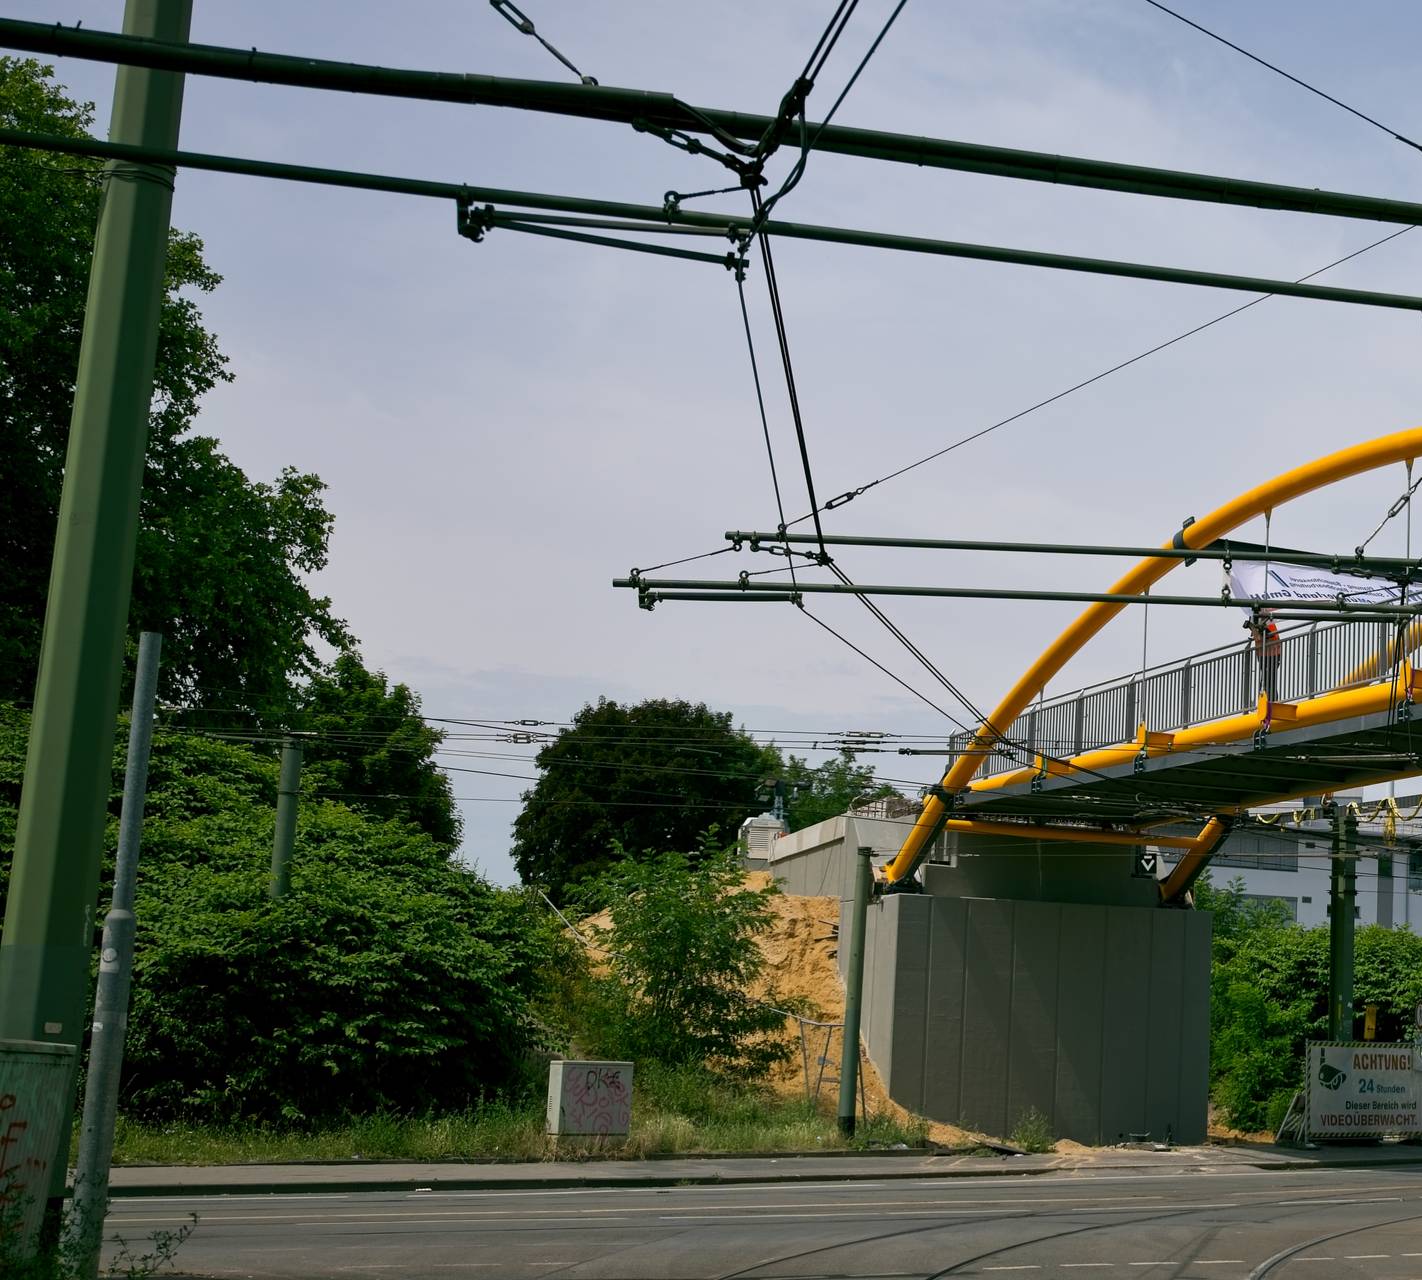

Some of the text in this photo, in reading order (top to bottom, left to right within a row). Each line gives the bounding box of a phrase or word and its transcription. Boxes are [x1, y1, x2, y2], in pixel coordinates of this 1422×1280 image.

[1353, 1053, 1411, 1071] ACHTUNG!
[1358, 1079, 1405, 1094] 24 Stunden
[1345, 1101, 1417, 1110] Dieser Bereich wird
[1320, 1111, 1418, 1127] VIDEOÜBERWACHT.
